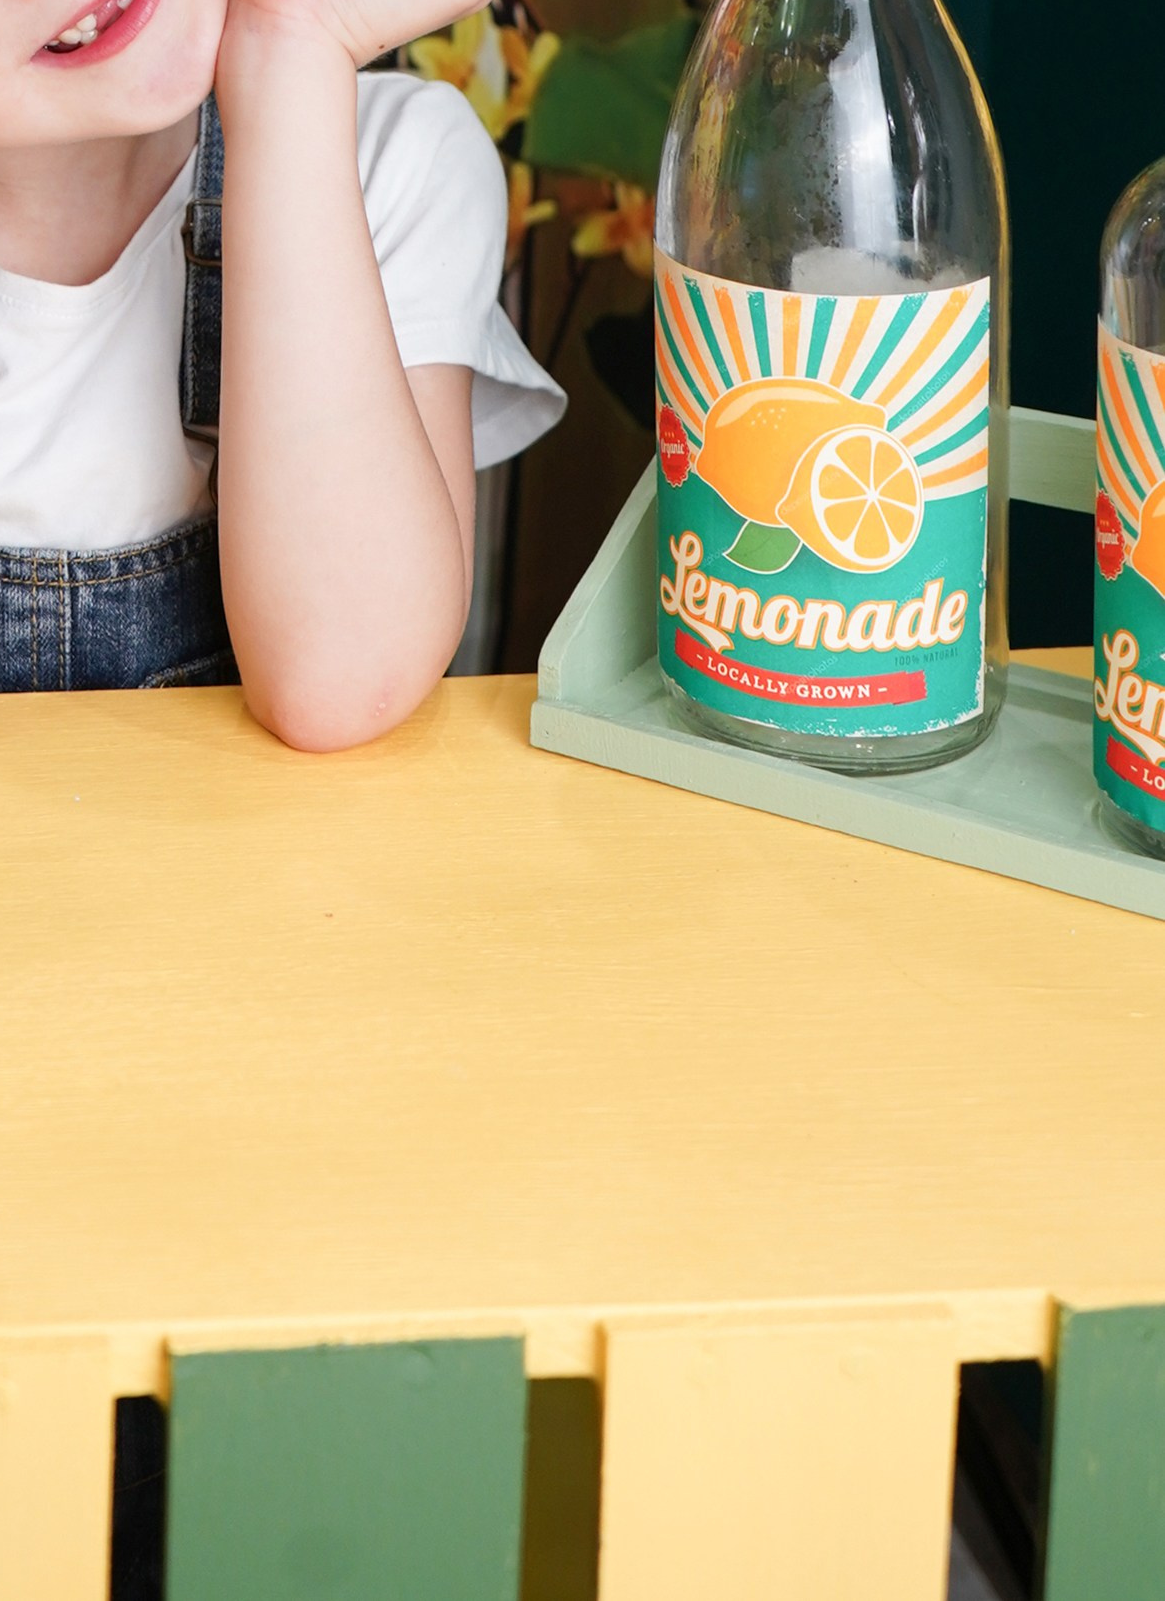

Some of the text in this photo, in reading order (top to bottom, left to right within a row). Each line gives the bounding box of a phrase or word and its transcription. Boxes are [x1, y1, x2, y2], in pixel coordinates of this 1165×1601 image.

[660, 530, 968, 652] Lemonade
[707, 657, 789, 695] LOCALLY
[796, 683, 871, 699] GROWN
[895, 647, 959, 667] 100% NATURAL
